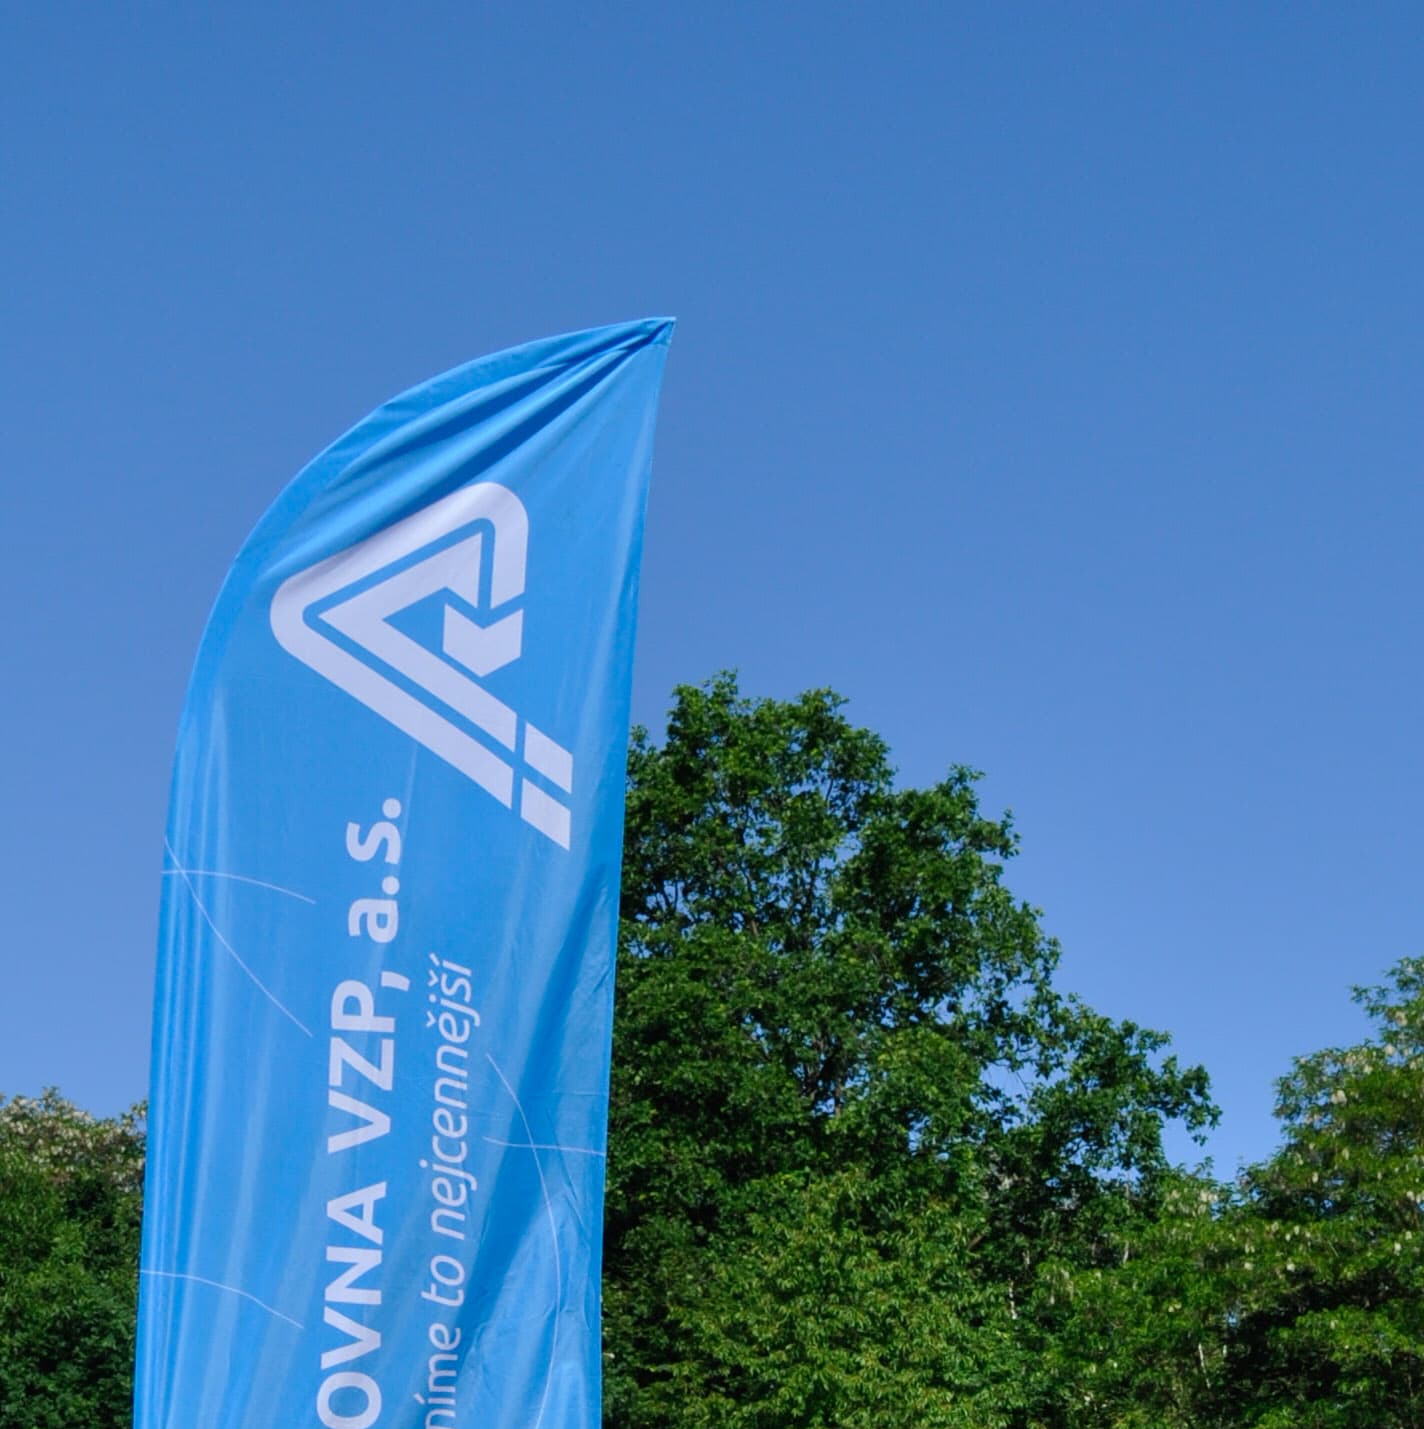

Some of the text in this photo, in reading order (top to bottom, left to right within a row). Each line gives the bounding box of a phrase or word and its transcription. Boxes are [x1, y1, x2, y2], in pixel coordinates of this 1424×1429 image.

[346, 797, 401, 944] a.s.
[327, 970, 411, 1154] VZP,
[418, 952, 481, 1240] nejcennější
[420, 1258, 466, 1308] to
